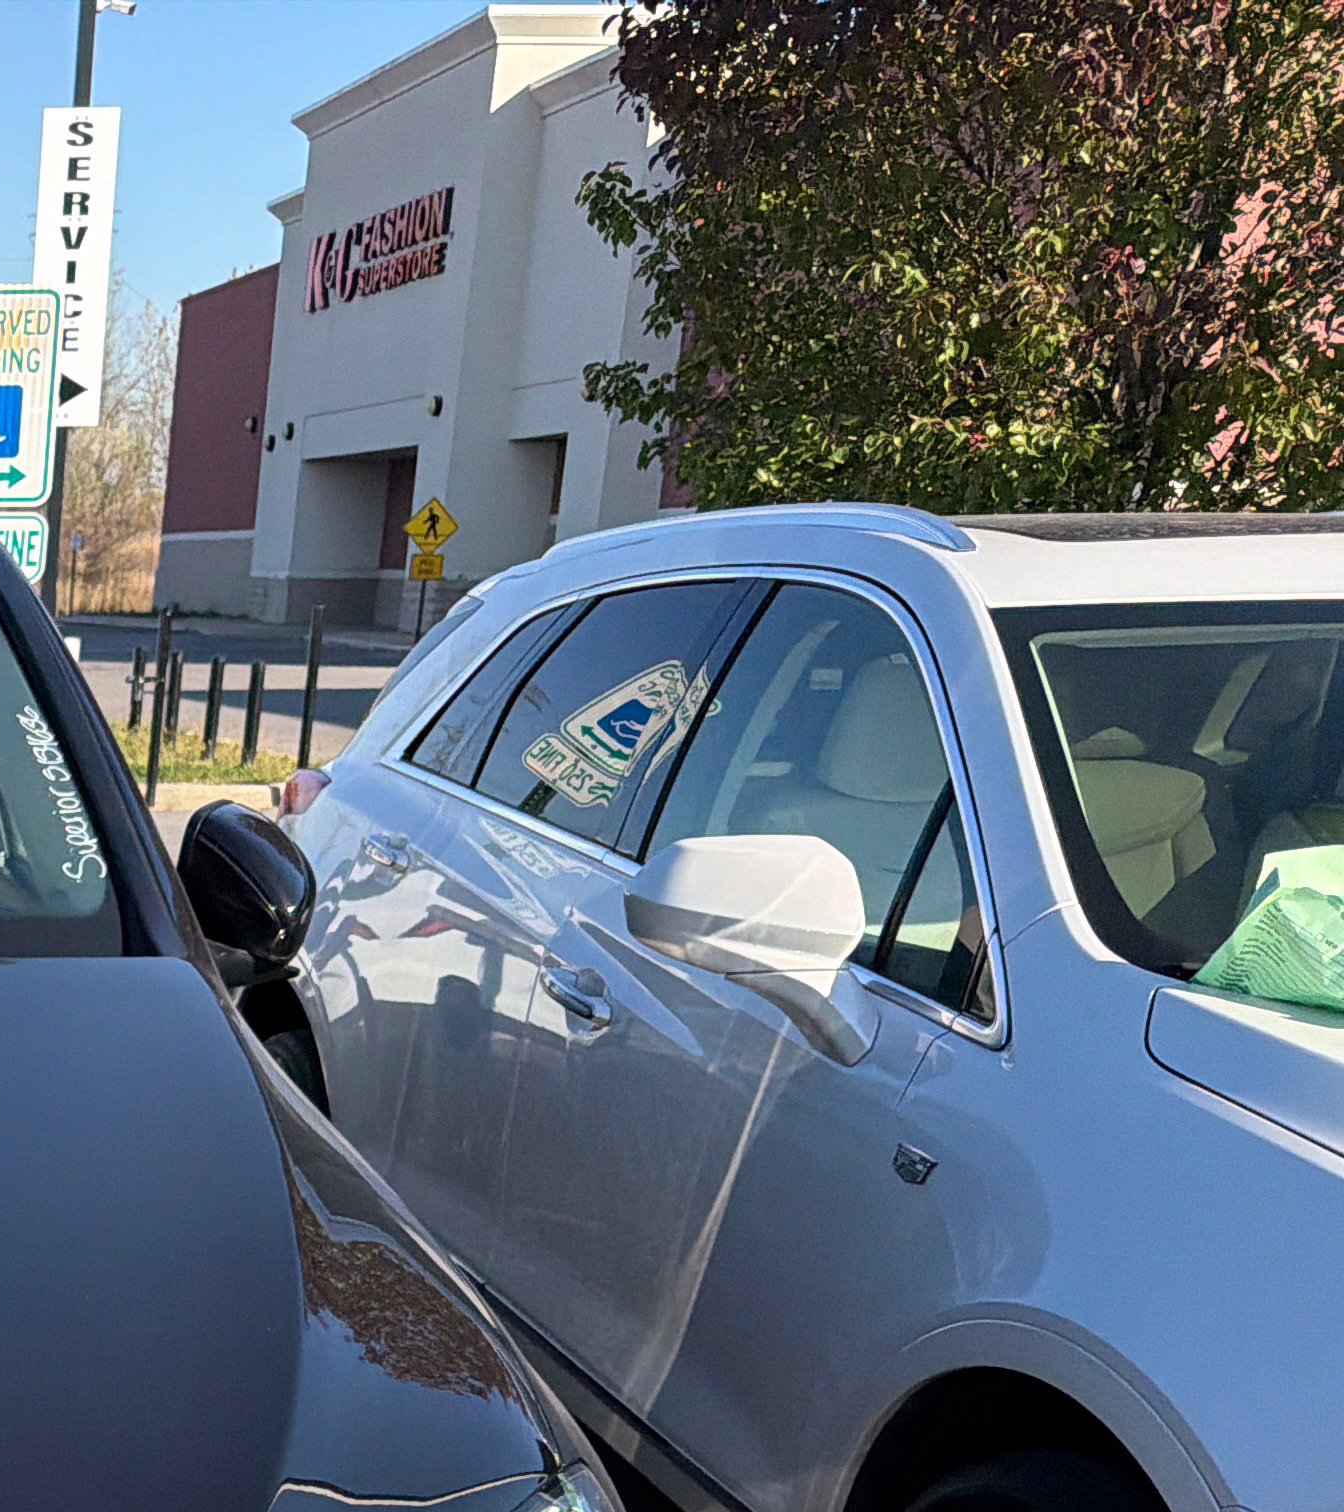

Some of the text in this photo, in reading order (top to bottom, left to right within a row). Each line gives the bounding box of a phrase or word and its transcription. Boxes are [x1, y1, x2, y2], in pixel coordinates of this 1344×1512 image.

[60, 121, 94, 352] SERVICE
[358, 187, 454, 262] FASHION
[357, 242, 447, 297] SUPERSTORE
[48, 785, 108, 884] Superior
